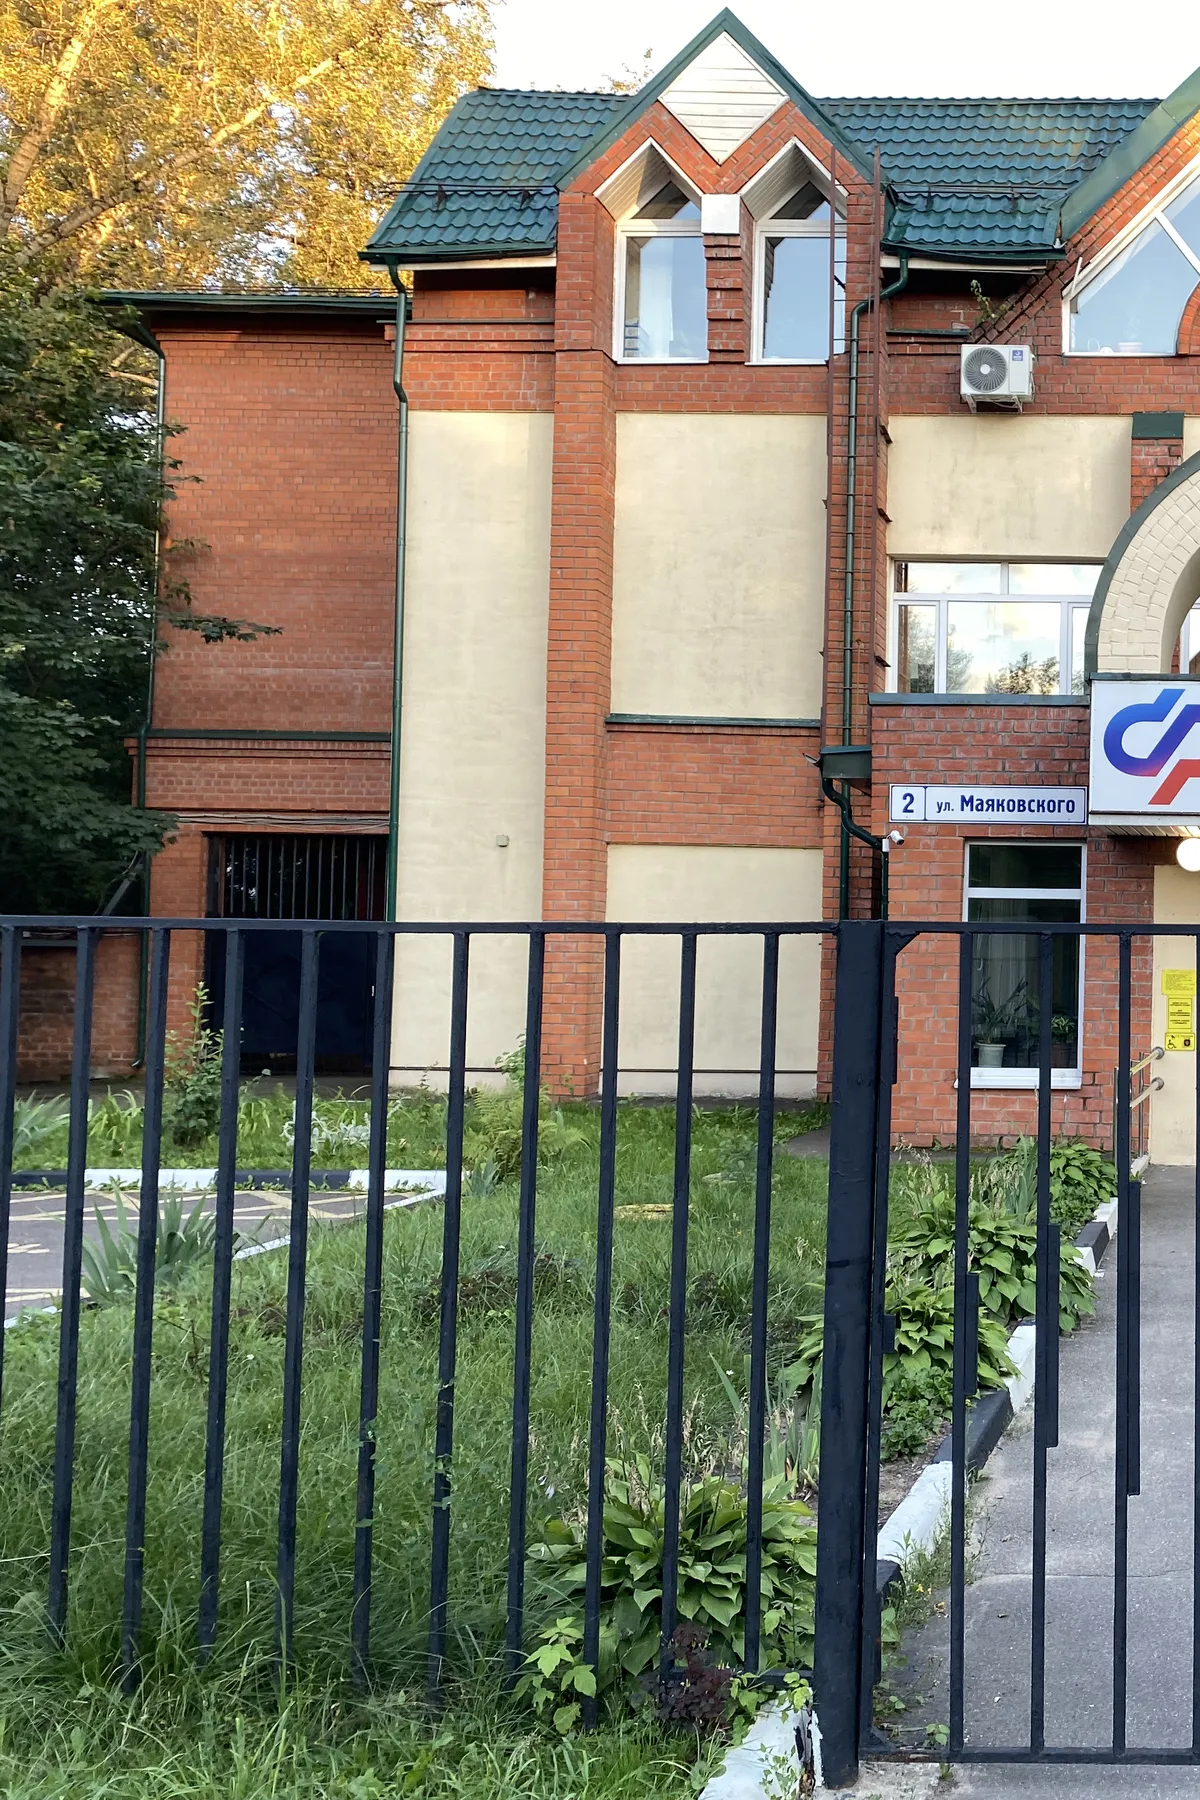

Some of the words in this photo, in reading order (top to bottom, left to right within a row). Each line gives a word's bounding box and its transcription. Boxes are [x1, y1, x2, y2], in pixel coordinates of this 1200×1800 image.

[902, 792, 915, 814] 2
[936, 801, 955, 814] ул.
[960, 794, 1076, 814] Маяковского
